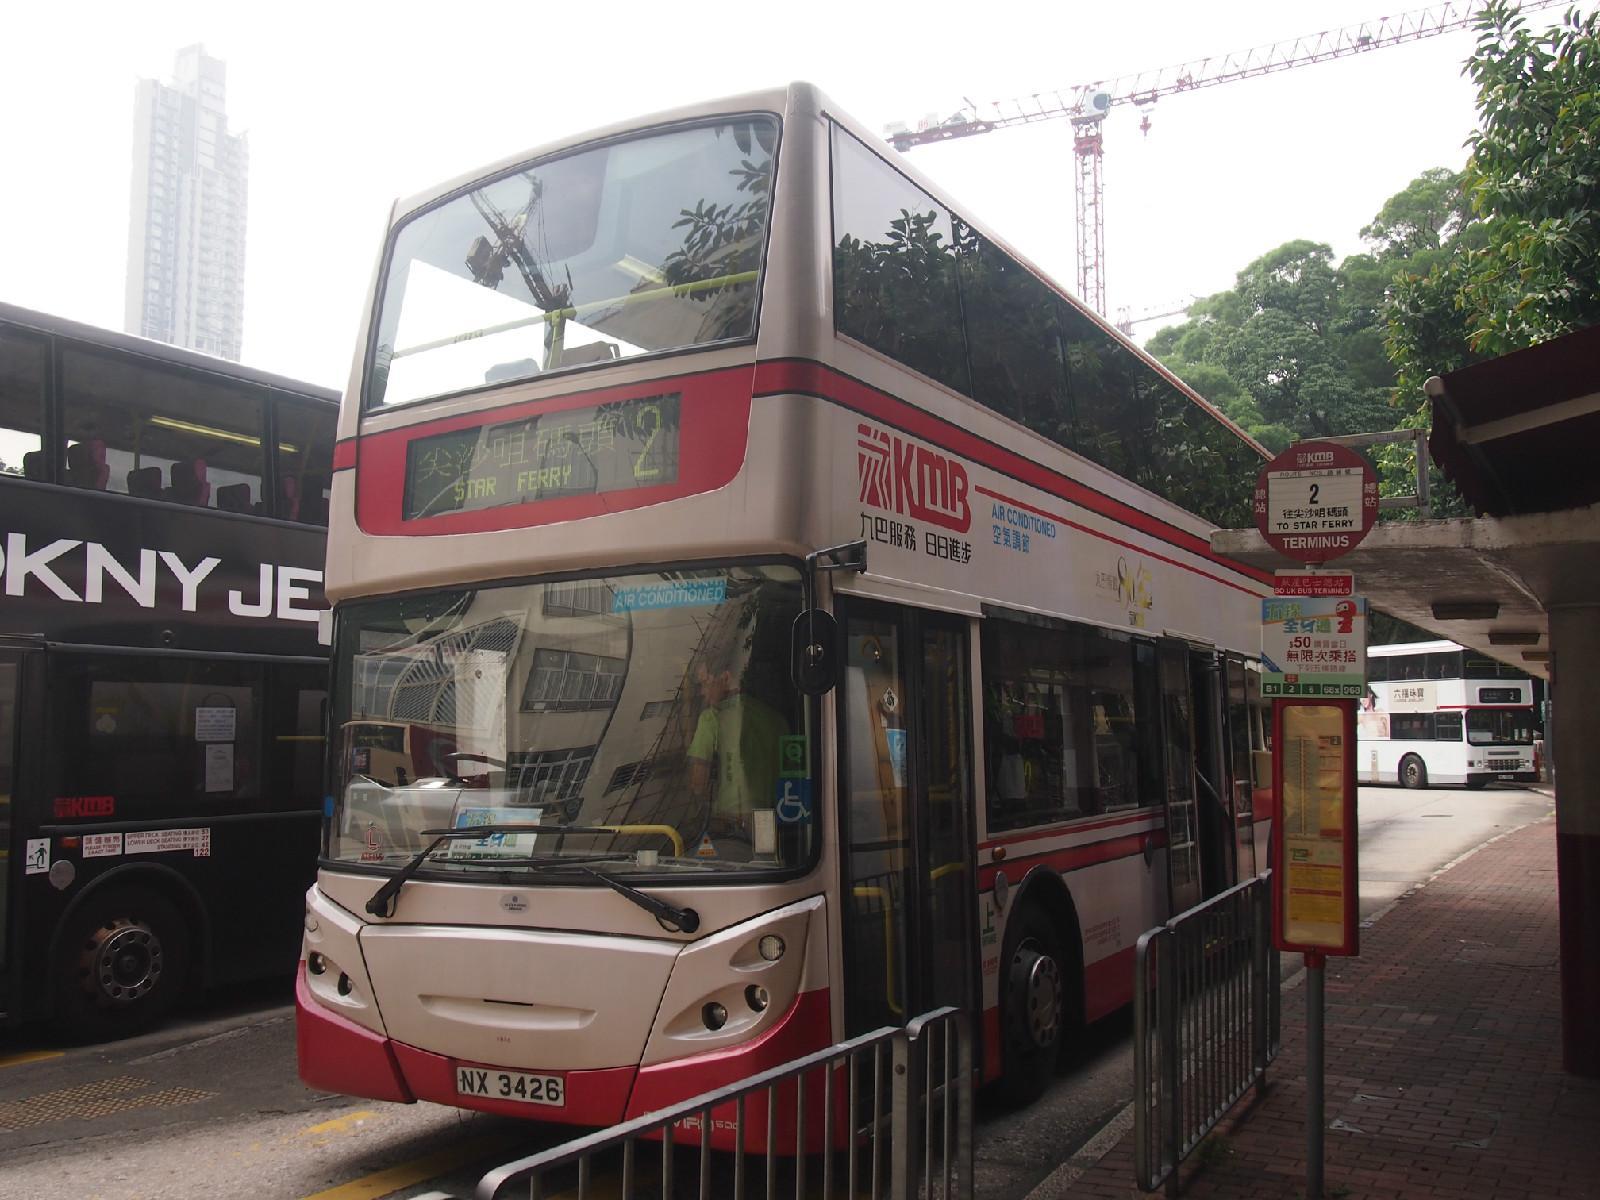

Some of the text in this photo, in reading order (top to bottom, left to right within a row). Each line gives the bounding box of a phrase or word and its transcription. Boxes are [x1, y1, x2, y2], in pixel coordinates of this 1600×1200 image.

[633, 404, 661, 477] 2
[1307, 451, 1334, 464] KMB
[454, 463, 572, 501] STAR FERRY
[893, 438, 972, 534] KMB
[1309, 483, 1320, 505] 2
[991, 503, 1057, 540] AIR CONDITIONED
[1276, 519, 1354, 531] TO STAR FERRY
[860, 511, 972, 565] 九巴服務 日日進步
[1282, 535, 1349, 550] TERMINUS
[0, 532, 222, 613] KNY
[615, 586, 724, 609] AIR CONDITIONED
[1289, 636, 1311, 648] $50
[1286, 649, 1357, 663] 無限次乘搭
[1288, 685, 1295, 693] 2
[460, 1070, 561, 1102] NX 3426
